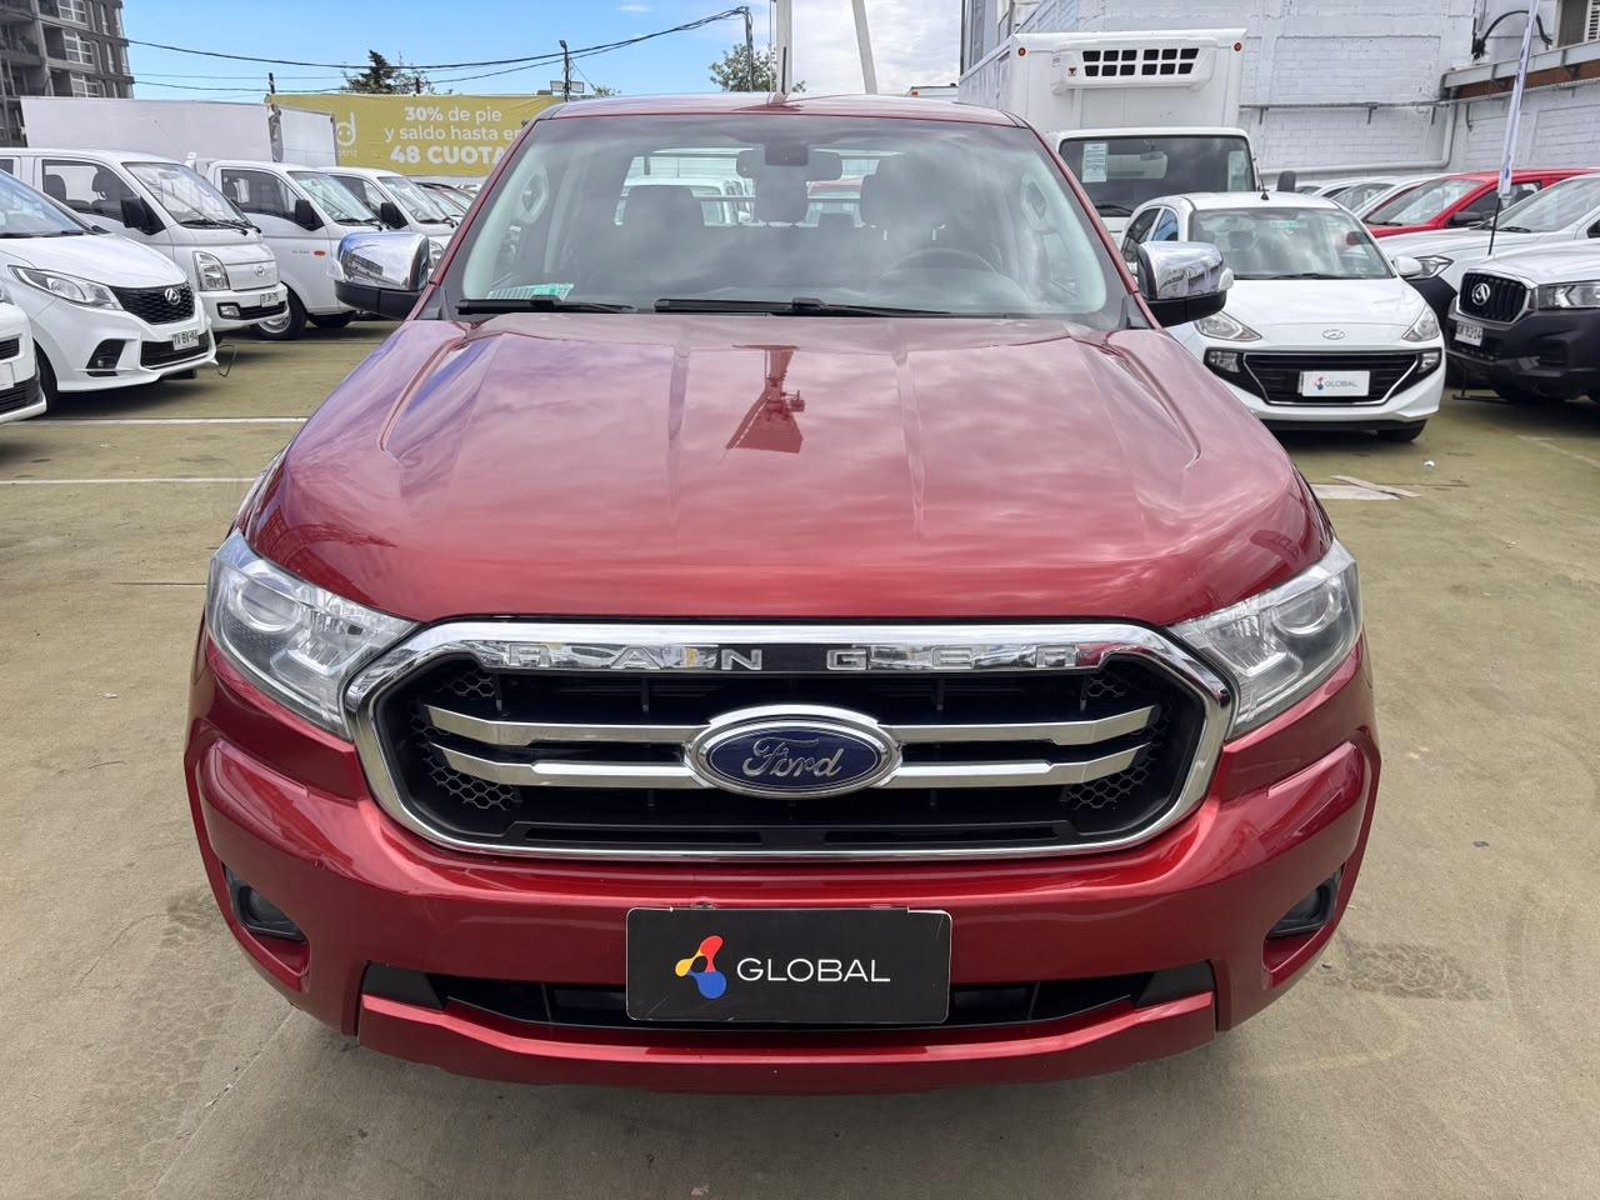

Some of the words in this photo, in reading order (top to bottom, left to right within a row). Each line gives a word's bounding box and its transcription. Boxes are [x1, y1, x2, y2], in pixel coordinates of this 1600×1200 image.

[405, 107, 443, 121] 30%
[448, 107, 470, 121] de
[476, 106, 502, 124] pie
[384, 128, 395, 142] y
[400, 126, 446, 140] saldo
[451, 126, 498, 140] hasta
[390, 146, 421, 164] 48
[507, 644, 1078, 671] RANGER
[742, 736, 844, 777] Ford
[736, 957, 891, 983] GLOBAL
